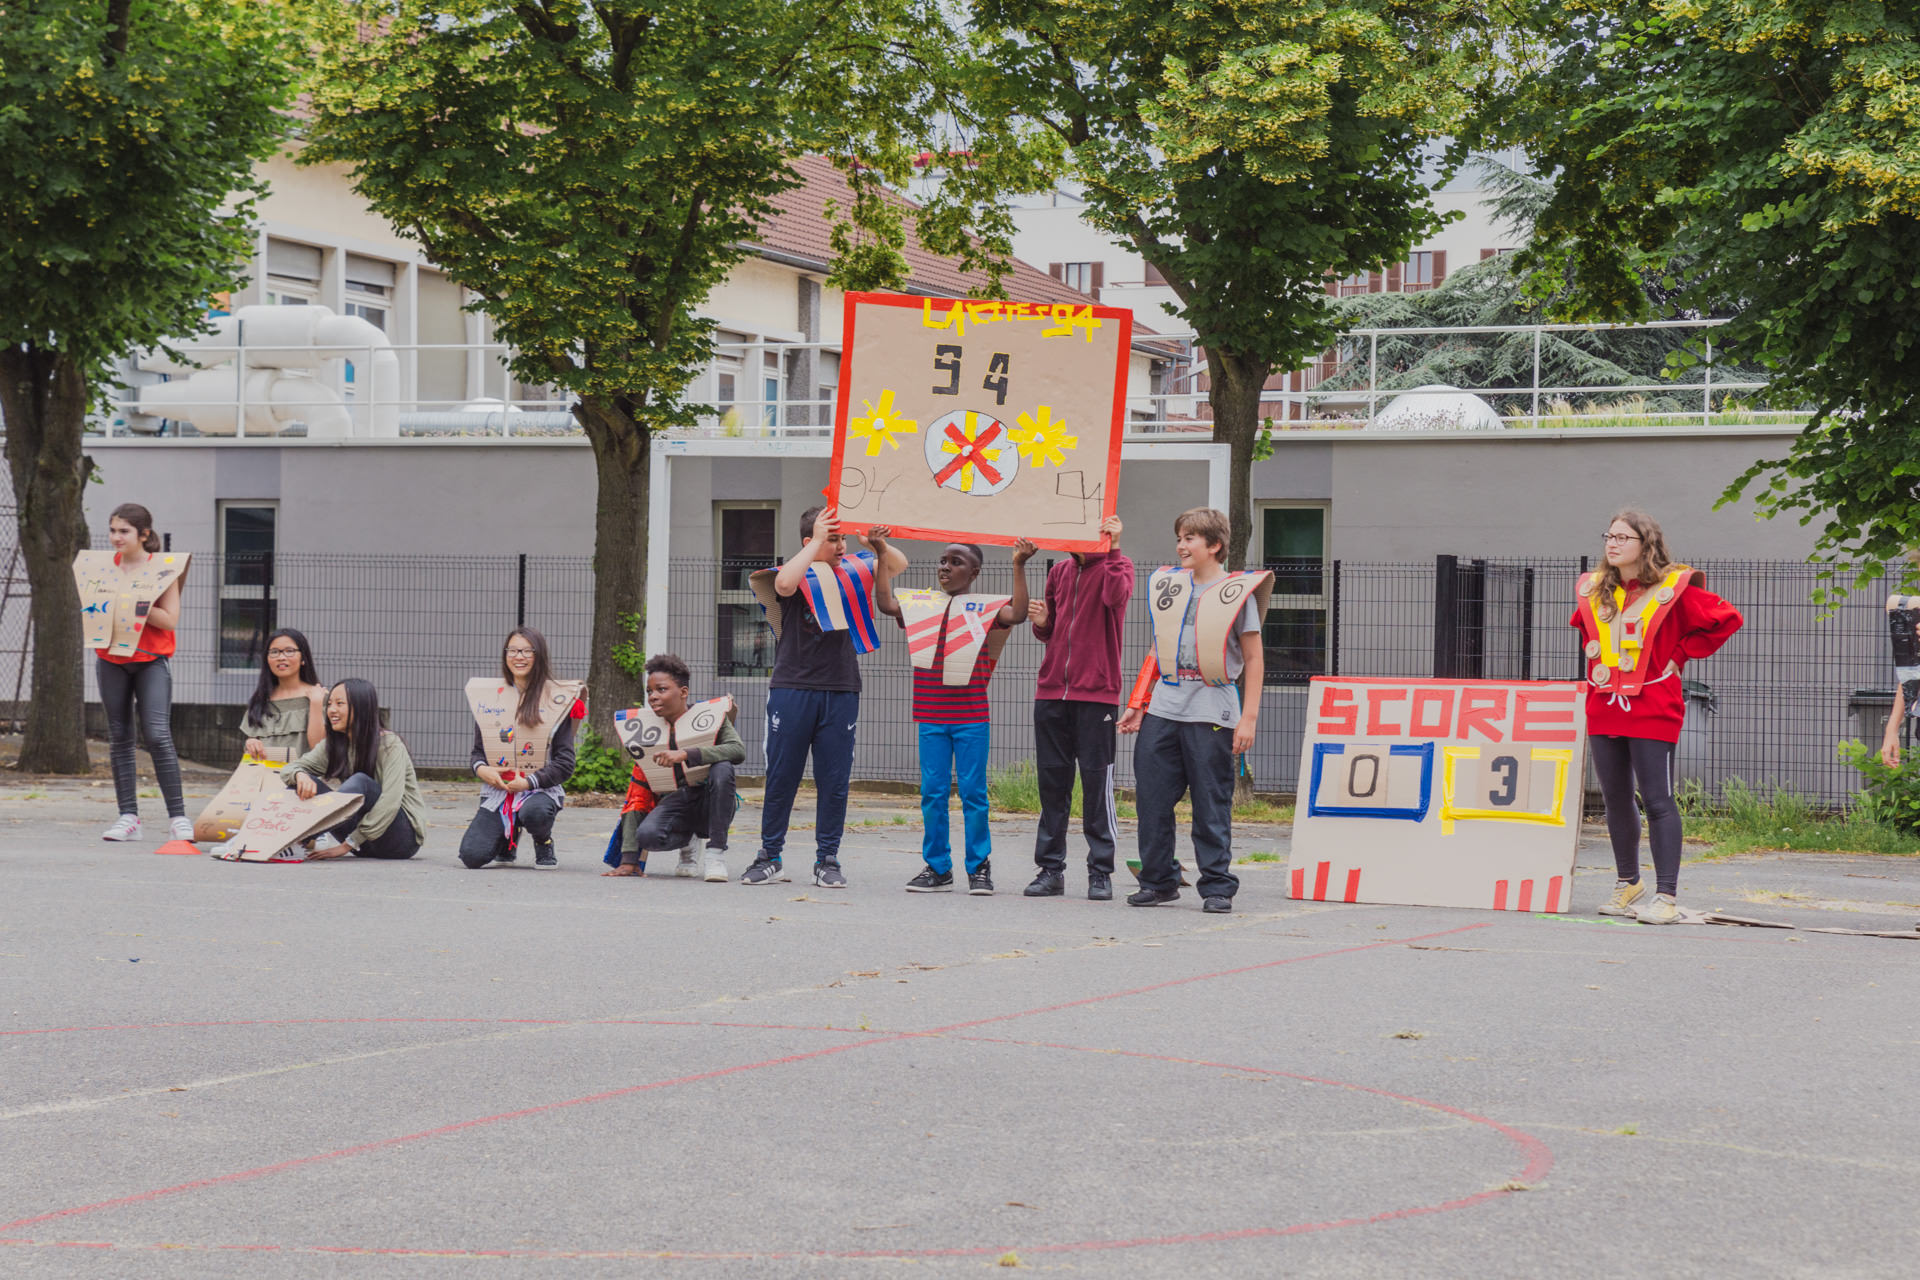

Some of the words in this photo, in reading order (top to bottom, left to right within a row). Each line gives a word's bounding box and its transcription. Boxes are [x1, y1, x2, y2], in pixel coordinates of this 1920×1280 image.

[1317, 687, 1577, 743] SCORE
[1348, 754, 1380, 798] 0
[1489, 756, 1518, 806] 3
